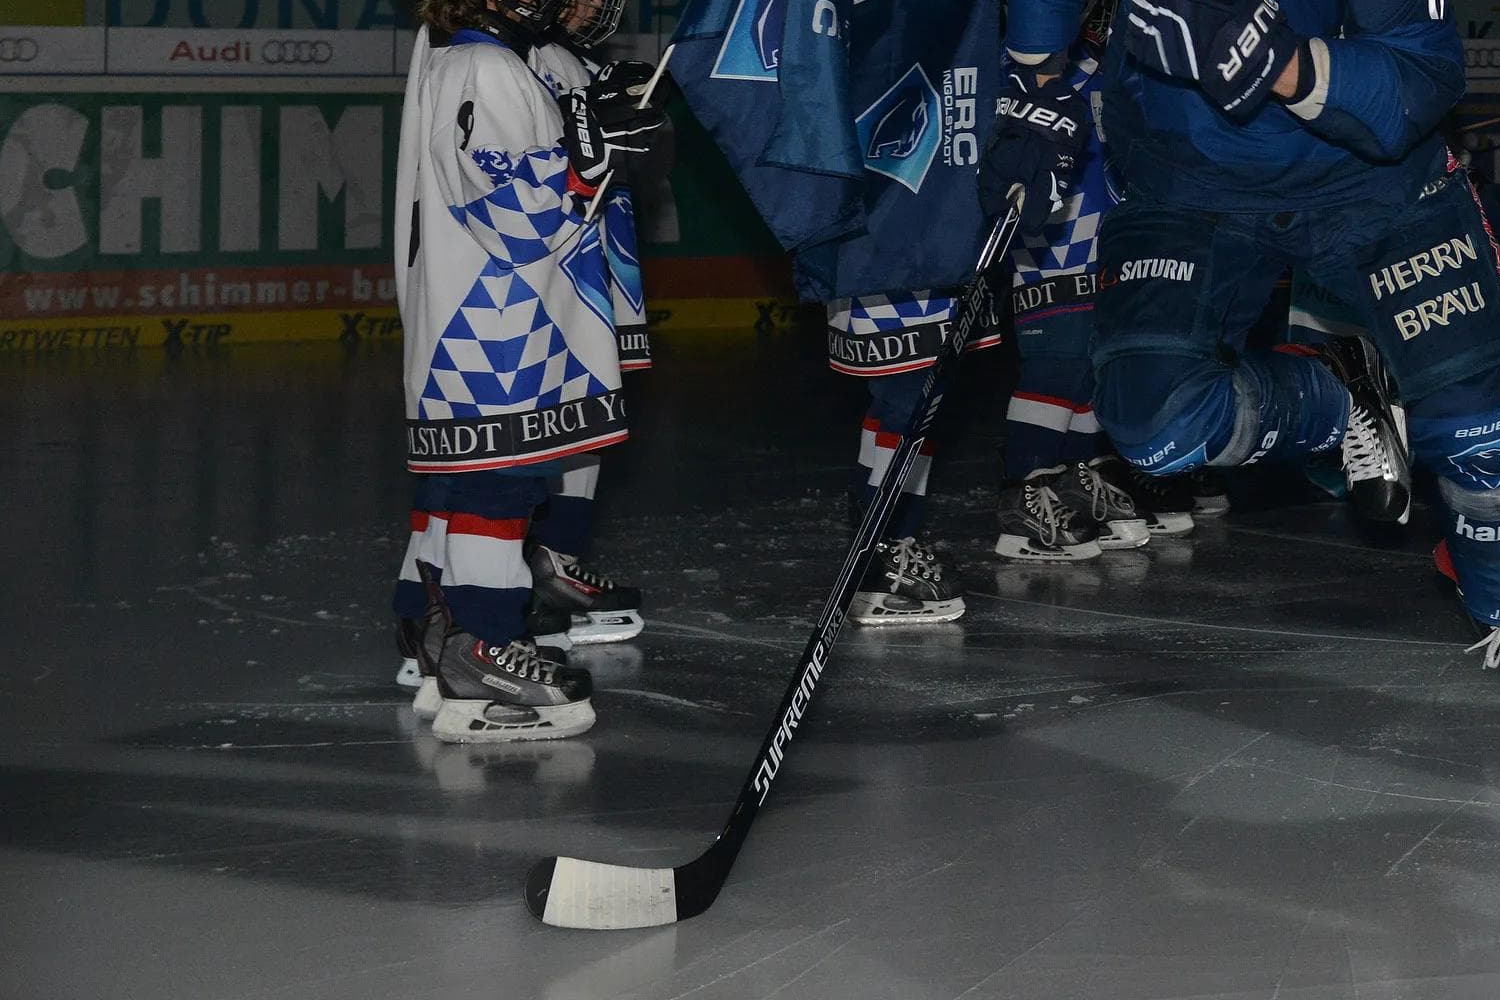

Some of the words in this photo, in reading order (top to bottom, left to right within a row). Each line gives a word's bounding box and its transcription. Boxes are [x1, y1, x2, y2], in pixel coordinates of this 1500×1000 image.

[169, 40, 250, 62] Audi
[942, 69, 953, 167] INGOLSTADT
[953, 66, 979, 167] ERC
[1119, 257, 1196, 283] SATURN
[1368, 233, 1479, 301] HERRN
[952, 279, 991, 354] BAUER
[1393, 281, 1486, 343] BRÄU
[823, 606, 845, 648] MX3
[754, 640, 828, 808] SUPREME
